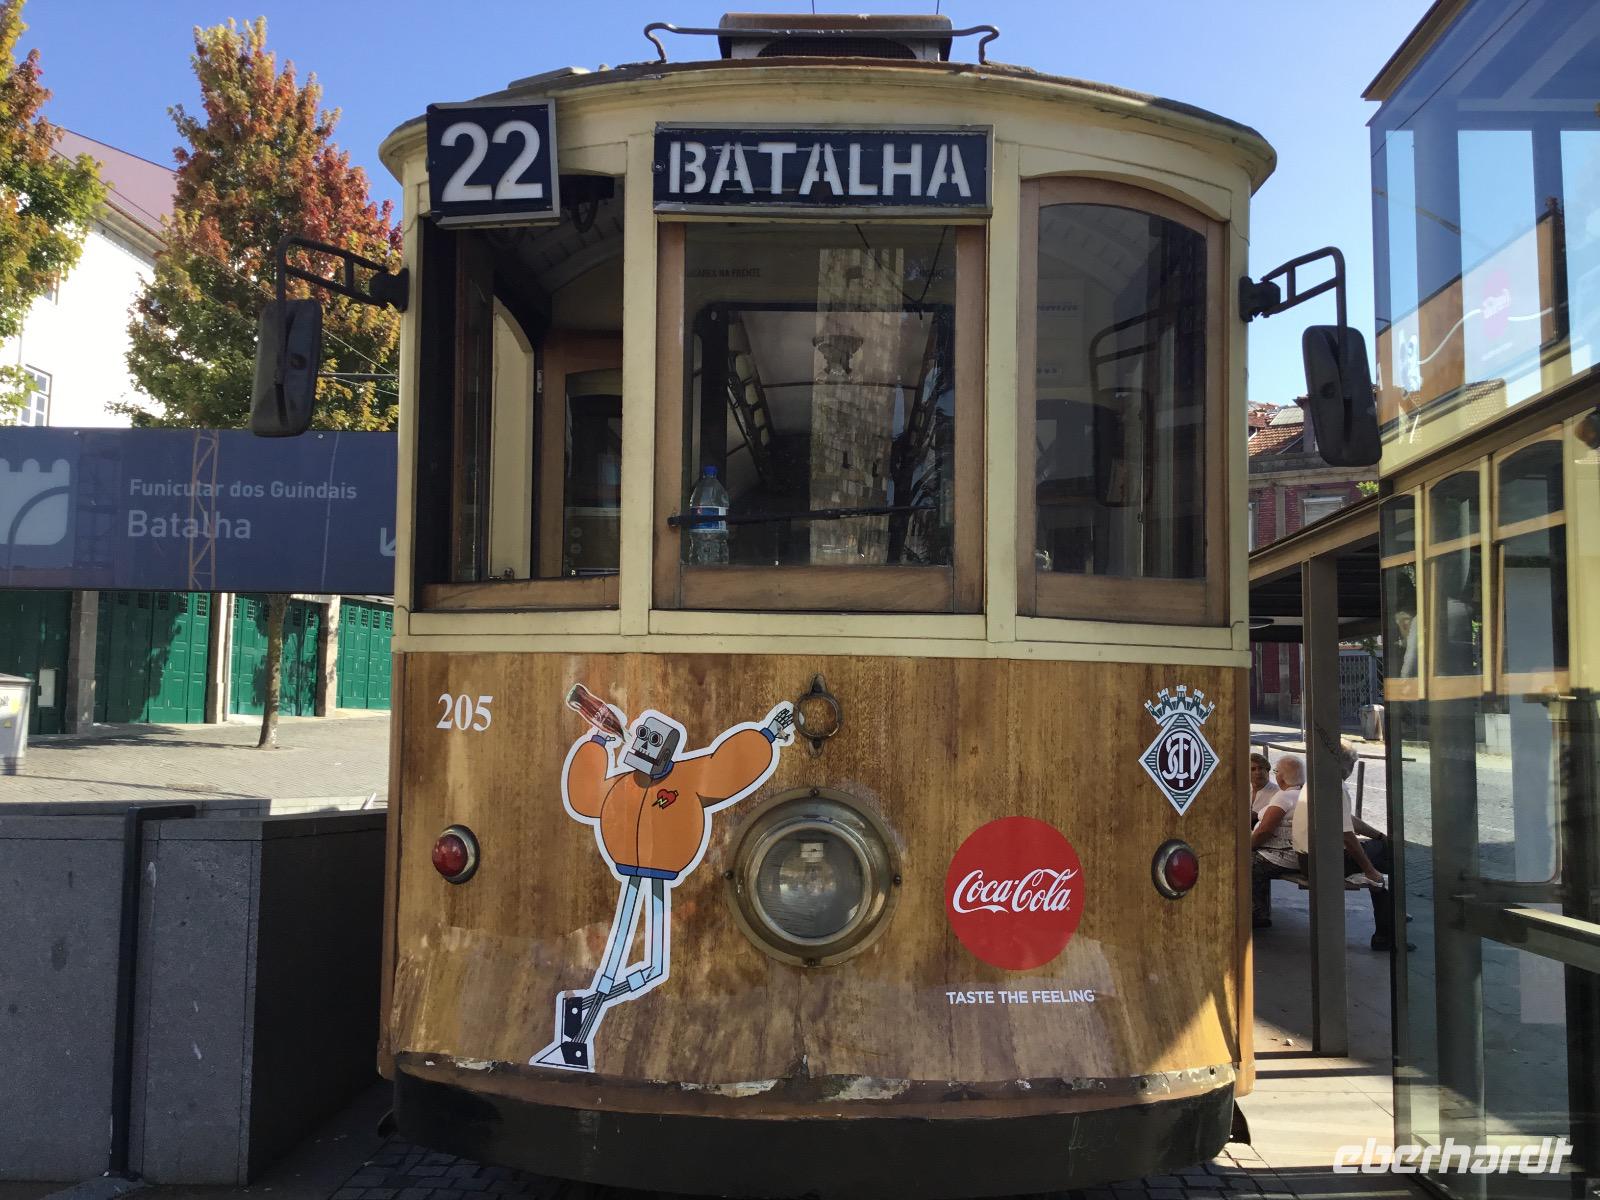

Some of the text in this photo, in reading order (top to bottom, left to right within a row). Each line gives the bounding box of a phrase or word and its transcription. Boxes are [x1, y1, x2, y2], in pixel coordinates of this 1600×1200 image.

[440, 121, 544, 202] 22
[669, 141, 971, 197] BATALHA
[129, 479, 358, 499] Funicular dos Guindais
[127, 509, 251, 539] Batalha
[436, 693, 494, 732] 205
[945, 989, 1096, 1005] TASTE THE FEELING
